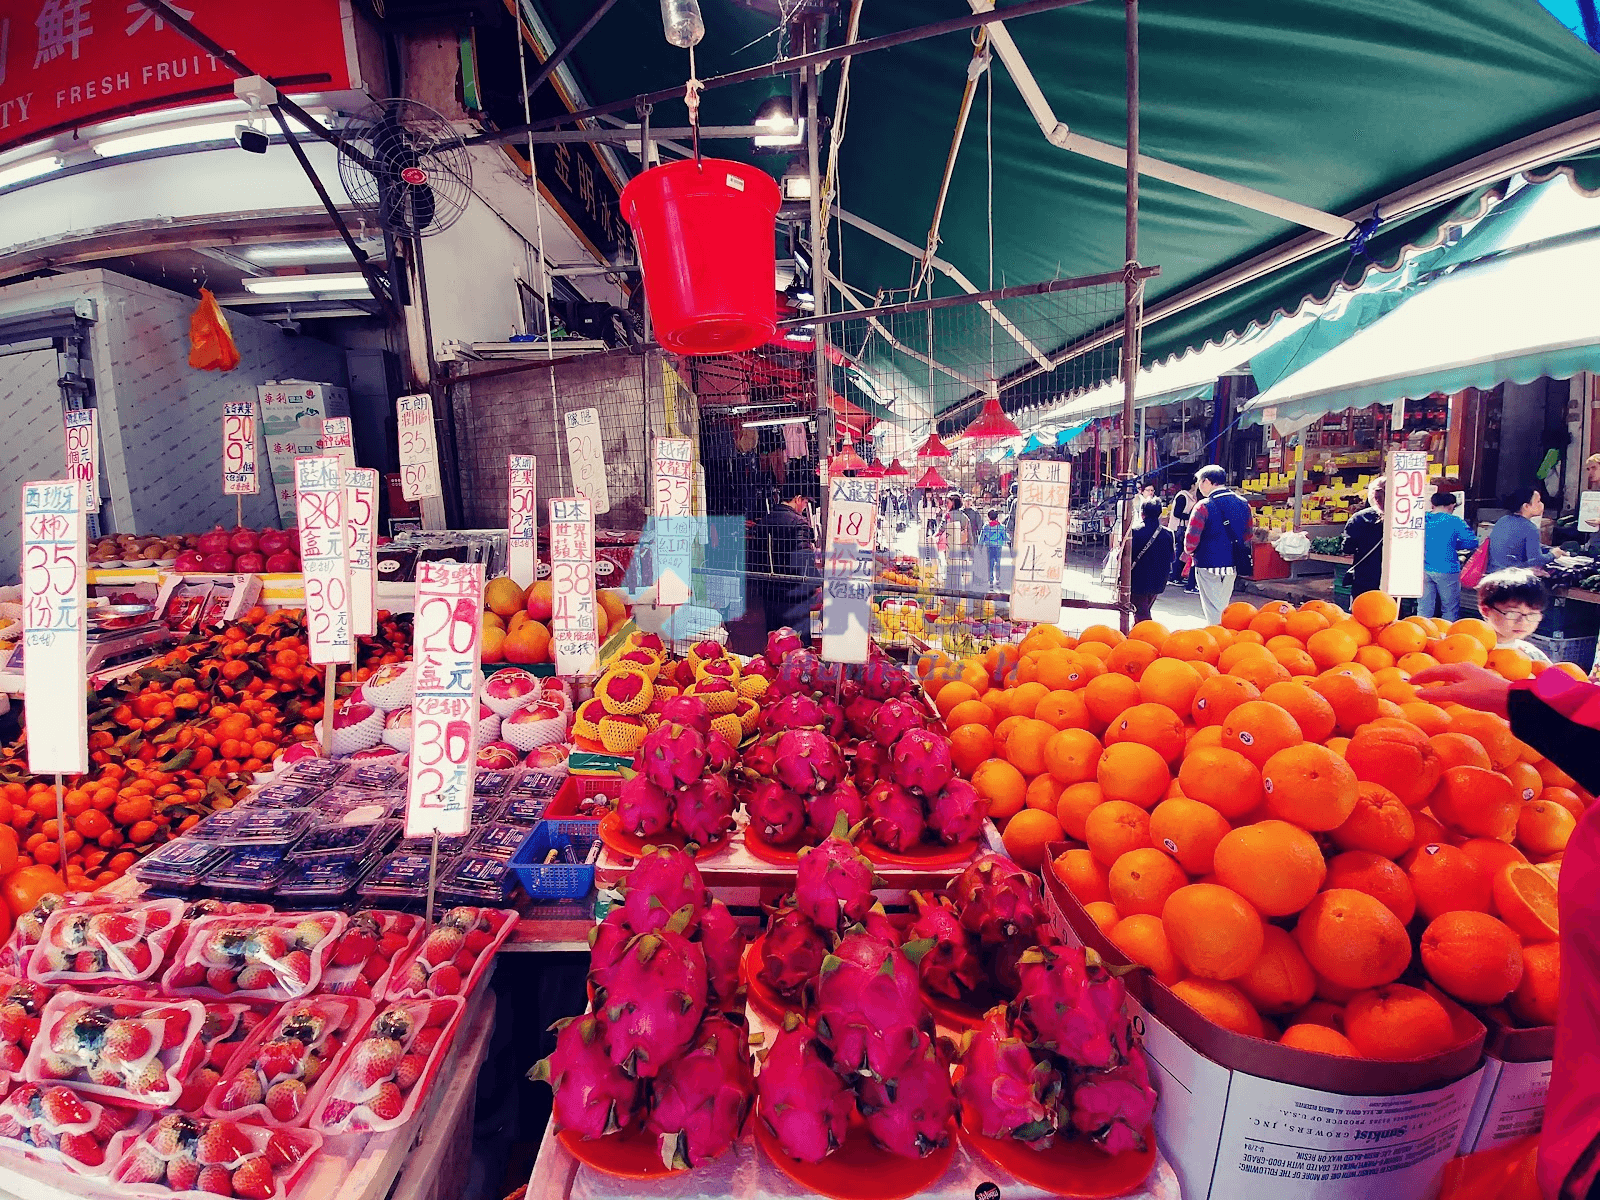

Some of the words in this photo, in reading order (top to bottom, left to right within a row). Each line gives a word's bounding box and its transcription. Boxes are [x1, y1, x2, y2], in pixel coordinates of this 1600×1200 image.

[56, 71, 130, 109] FRESH
[400, 396, 428, 412] 元朗
[68, 425, 89, 451] 60
[226, 415, 252, 442] 20
[244, 441, 253, 451] 元
[401, 430, 426, 454] 35
[569, 435, 592, 465] 30
[658, 440, 689, 459] 越南
[226, 442, 244, 474] 9
[68, 462, 93, 481] 100
[405, 464, 426, 486] 60
[657, 460, 690, 479] 火龍果
[1024, 462, 1061, 483] 澳洲
[409, 483, 422, 496] 2
[657, 478, 689, 505] 35
[1394, 470, 1423, 497] 20
[26, 485, 74, 511] 西班牙
[510, 488, 533, 514] 50
[1413, 496, 1424, 510] 元
[553, 500, 587, 521] 日本
[658, 503, 673, 532] 4
[674, 504, 689, 518] 元
[1395, 497, 1411, 525] 9
[511, 513, 524, 535] 2
[555, 523, 588, 541] 世界
[836, 511, 863, 536] 18
[1021, 505, 1064, 547] 25
[304, 531, 343, 557] 盒元
[356, 528, 370, 544] 元
[554, 539, 591, 559] 蘋果
[27, 544, 77, 596] 35
[829, 548, 873, 579] 份元
[1019, 544, 1045, 581] 4
[1051, 547, 1063, 559] 元
[555, 562, 592, 596] 38
[307, 577, 345, 613] 30
[25, 596, 77, 629] 份元
[554, 595, 577, 629] 4
[577, 597, 592, 614] 元
[576, 614, 593, 629] 個
[314, 613, 331, 644] 2
[335, 611, 347, 626] 元
[420, 597, 477, 654] 20
[417, 654, 473, 690] 盒元
[417, 719, 472, 765] 30
[417, 767, 446, 809] 2
[447, 765, 467, 786] 元
[443, 784, 468, 811] 盒
[1249, 1117, 1278, 1129] INC.
[1279, 1109, 1307, 1120] U.S.A.
[1284, 1123, 1350, 1138] GROWERS,
[1354, 1125, 1408, 1144] Sunkist
[1242, 1153, 1286, 1168] FOOD-GRADE
[1286, 1160, 1305, 1170] WITH
[1296, 1151, 1317, 1162] RESIN.
[1306, 1163, 1331, 1172] COATED
[1317, 1155, 1327, 1163] OR
[1328, 1154, 1343, 1163] WAX
[1238, 1163, 1279, 1177] FOLLOWING:
[1279, 1169, 1291, 1179] THE
[1291, 1171, 1301, 1180] OF
[1302, 1172, 1321, 1182] MORE
